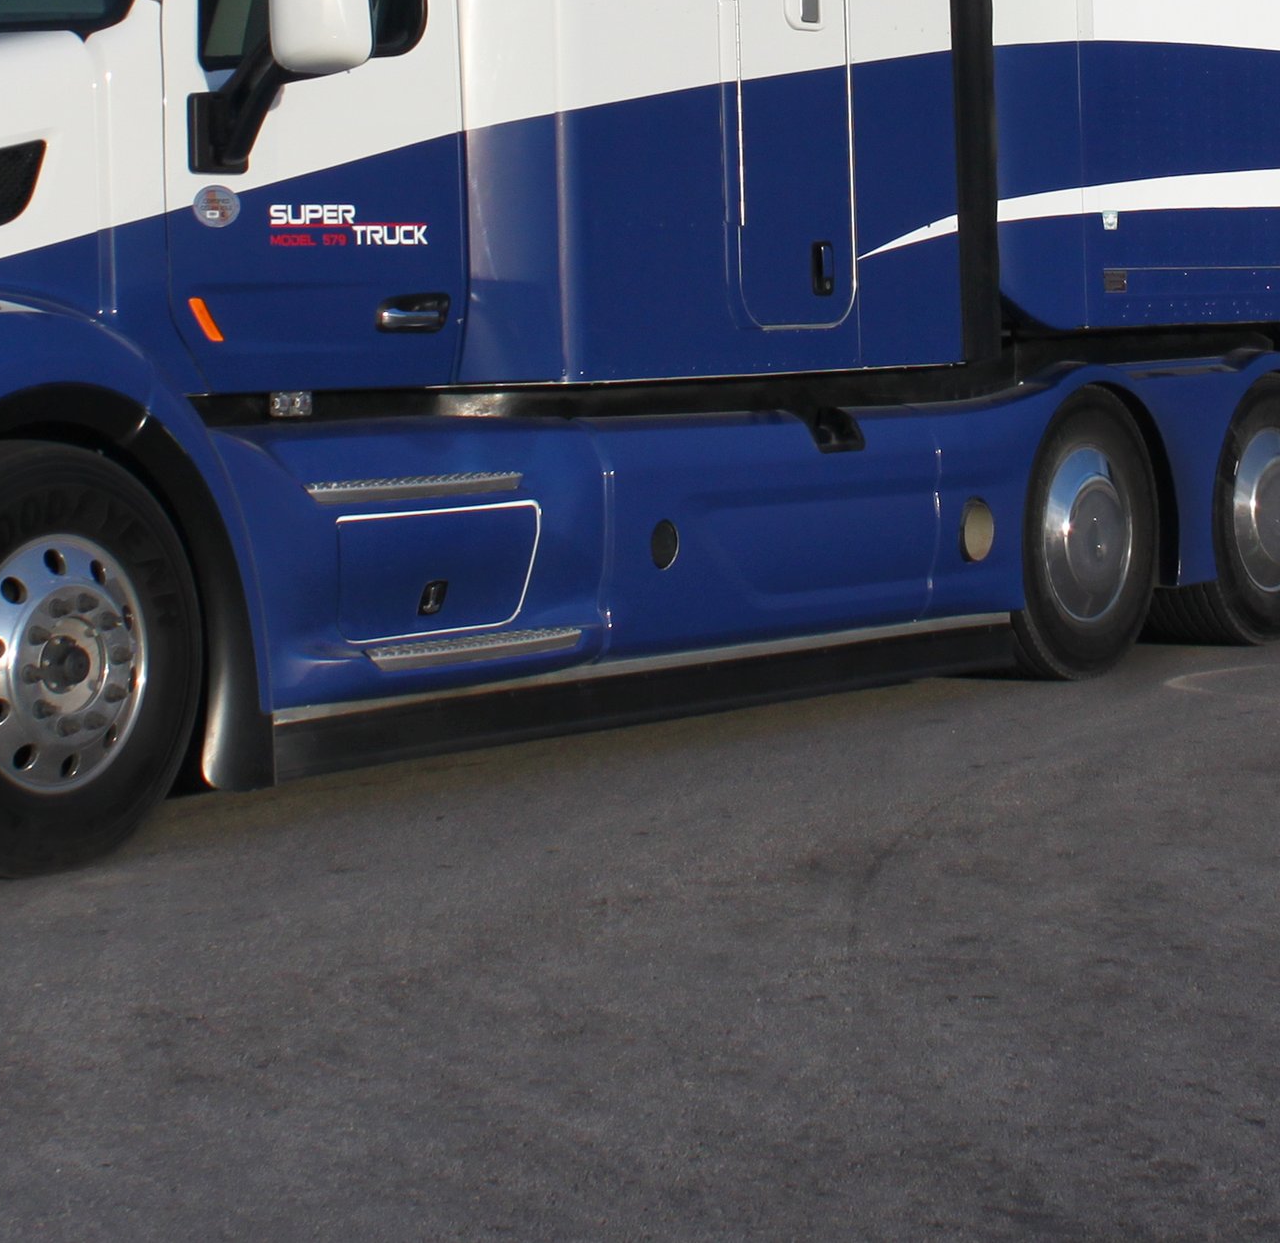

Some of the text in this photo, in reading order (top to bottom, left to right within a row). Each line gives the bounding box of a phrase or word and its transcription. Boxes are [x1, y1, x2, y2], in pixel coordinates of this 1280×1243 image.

[269, 204, 356, 225] SUPER
[270, 234, 347, 246] MODEL 579
[352, 225, 429, 245] TRUCK
